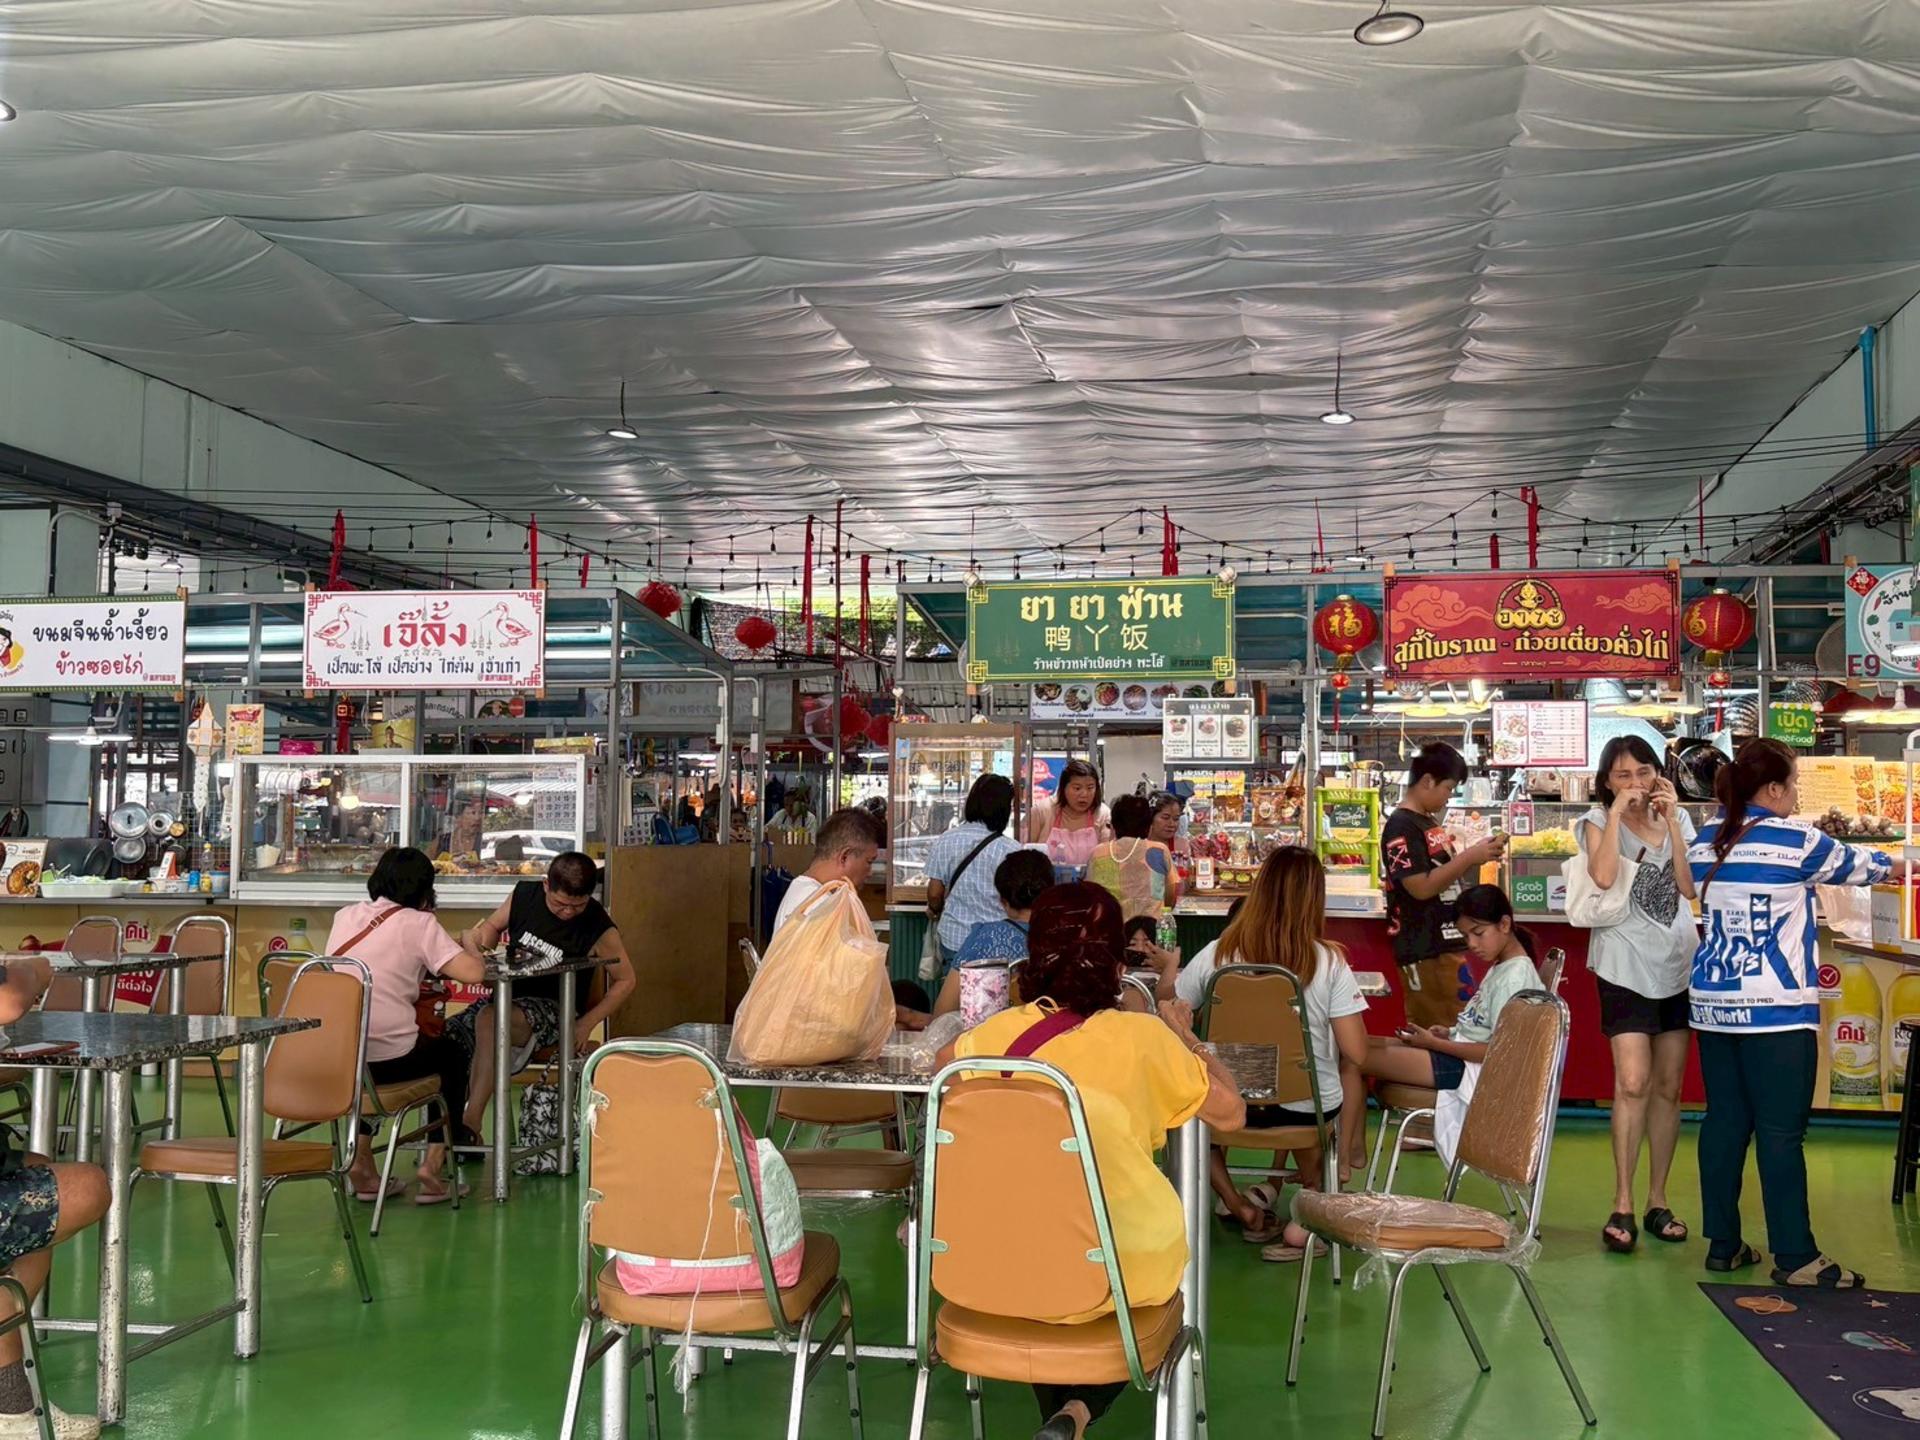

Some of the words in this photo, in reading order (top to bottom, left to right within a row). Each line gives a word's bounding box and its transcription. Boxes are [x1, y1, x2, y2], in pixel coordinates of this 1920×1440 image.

[1020, 595, 1055, 622] ยา
[1069, 594, 1105, 621] ยา
[1117, 586, 1184, 620] ฟ่าน
[32, 608, 169, 642] ขนมจีนน้ำเงี้ยว
[1393, 627, 1497, 671] สุกี้โบราณ
[1514, 624, 1669, 661] ก๋วยเตี๋ยวคั่วไก่
[56, 650, 143, 675] ข้าวซอยไก่
[387, 656, 432, 673] เป็ดย่าง
[439, 657, 474, 673] ไก่ต้ม
[480, 656, 521, 674] เจ้าเก่า
[1136, 652, 1165, 669] พะโล้
[1847, 654, 1881, 677] E9
[1777, 711, 1808, 728] เปิด
[1516, 882, 1543, 891] Grab
[1516, 892, 1544, 902] Food
